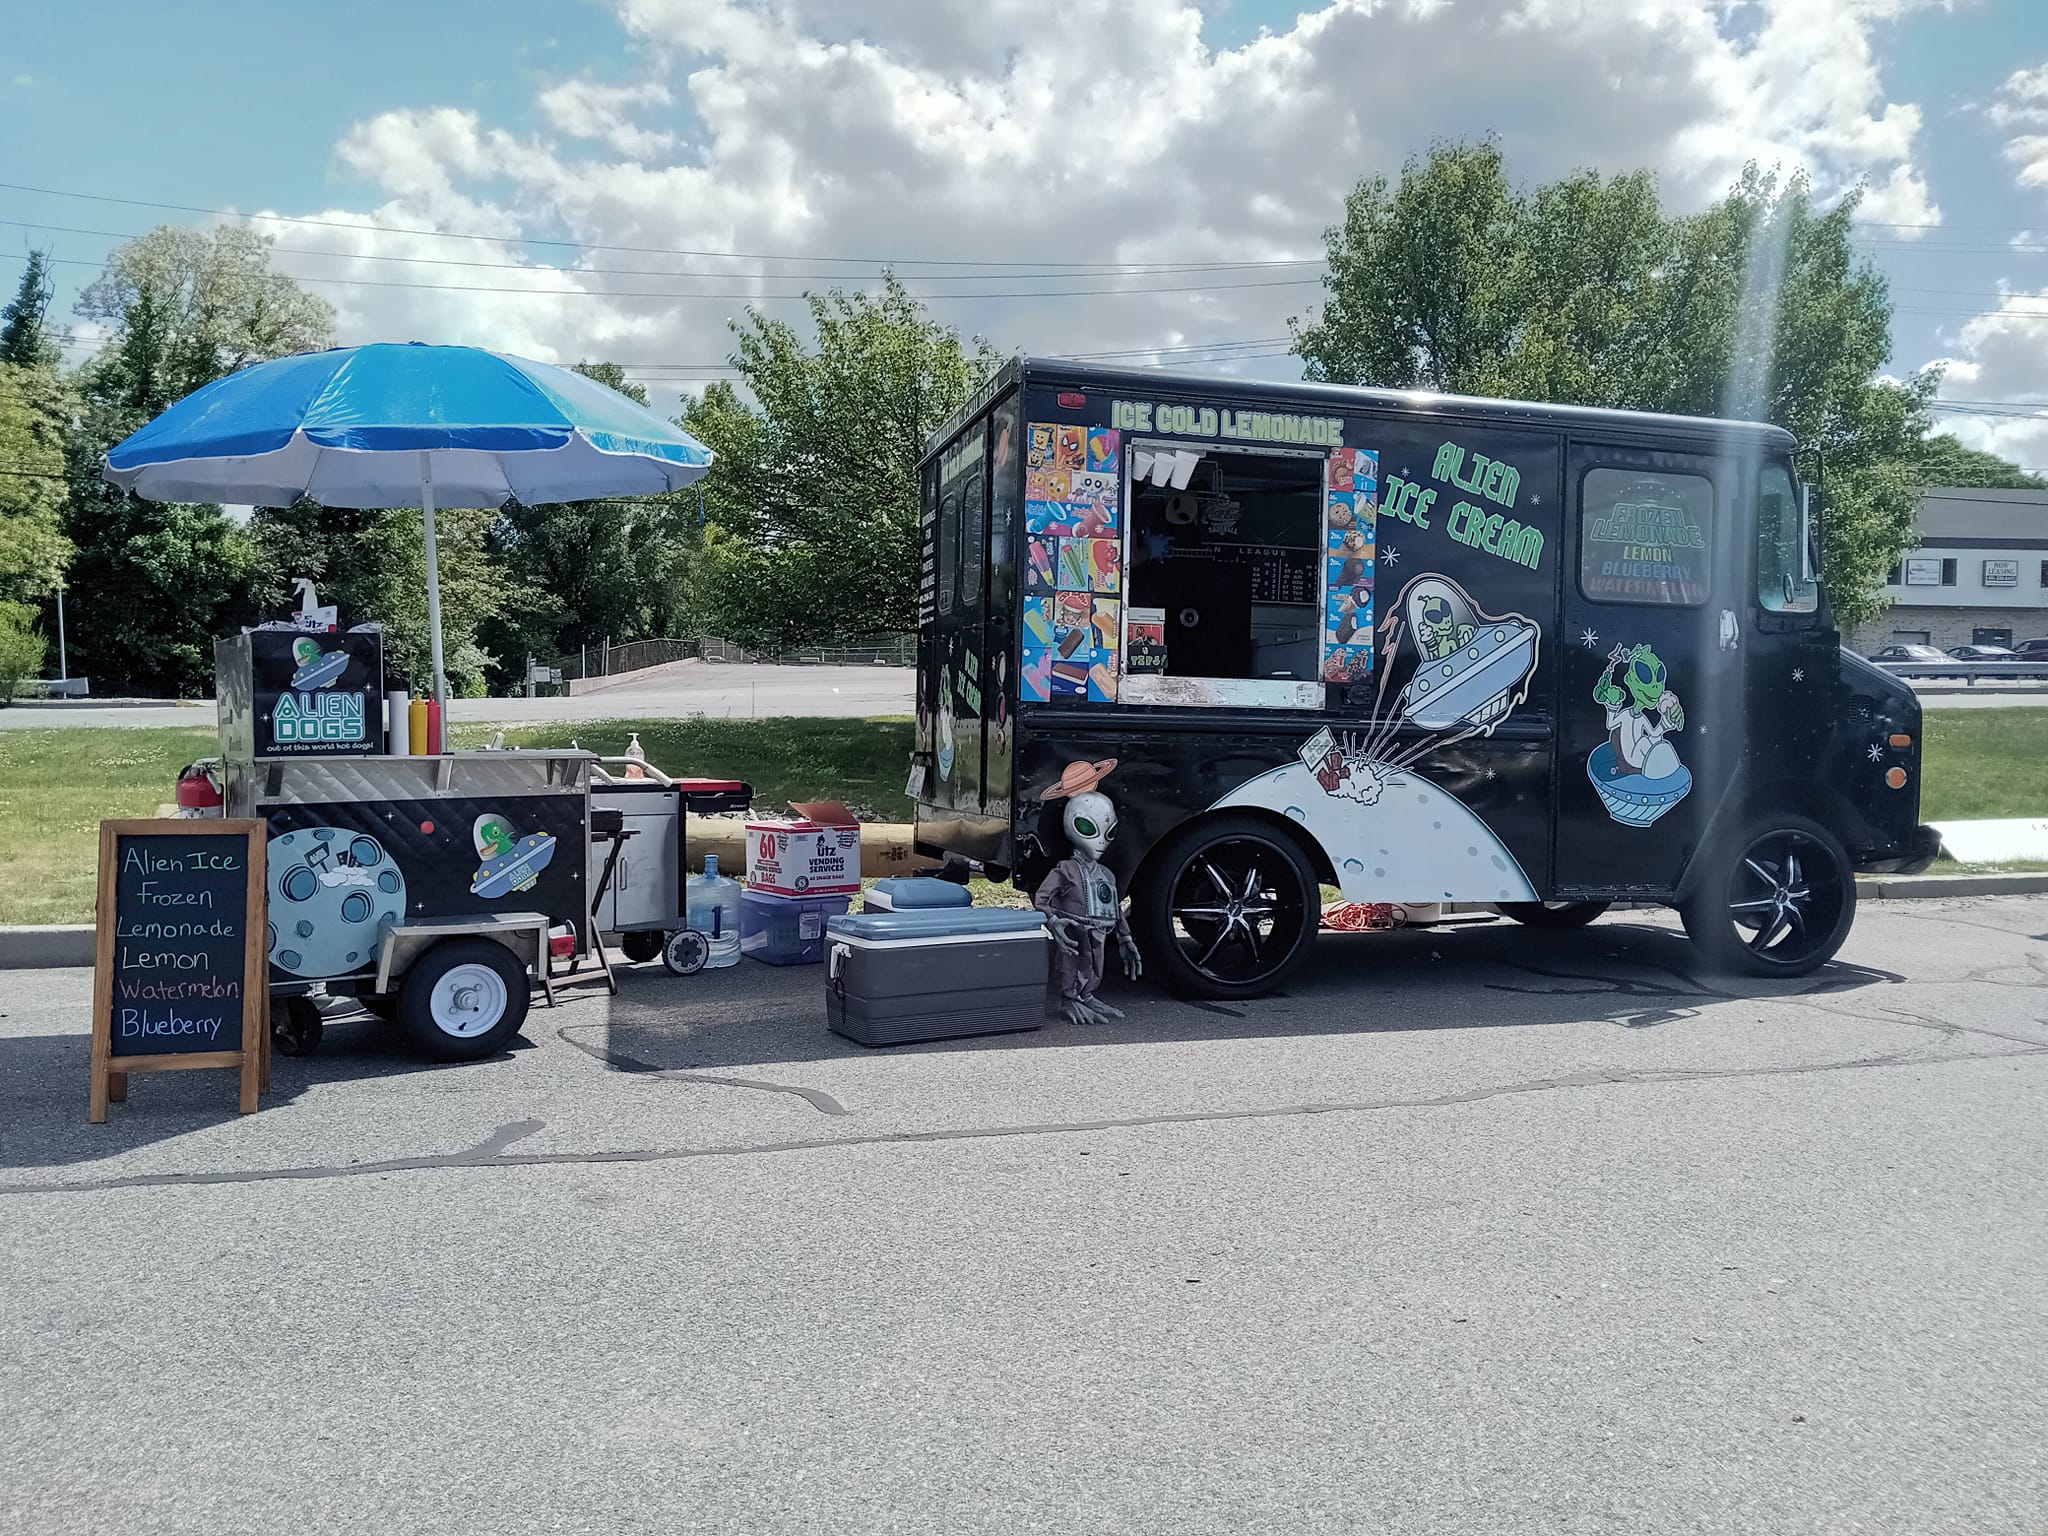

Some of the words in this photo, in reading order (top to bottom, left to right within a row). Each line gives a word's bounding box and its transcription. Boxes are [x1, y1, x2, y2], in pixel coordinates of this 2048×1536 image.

[1112, 400, 1152, 431] ICE
[1156, 404, 1218, 437] COLD
[1221, 409, 1344, 447] LEMONADE
[1432, 441, 1520, 508] ALIEN
[1378, 474, 1438, 529] ICE
[1447, 501, 1544, 570] CREAM
[1612, 504, 1685, 528] FROZEN
[1592, 520, 1705, 548] LEMONADE
[1239, 547, 1287, 557] LEAGUE
[1623, 546, 1672, 562] LEMON
[1601, 561, 1692, 580] BLUEBERRY
[273, 692, 365, 718] ALIEN
[274, 717, 366, 743] DOGS
[266, 744, 282, 752] out
[282, 744, 293, 752] of
[293, 743, 310, 751] this
[311, 742, 335, 750] world
[336, 741, 351, 750] hot
[352, 741, 374, 751] dogs!
[759, 833, 776, 860] 60
[124, 848, 183, 875] Alien
[186, 852, 241, 870] Ice
[808, 857, 844, 866] VENDING
[808, 865, 844, 873] SERVICES
[761, 872, 776, 884] BAGS
[136, 881, 213, 909] Frozen
[117, 916, 235, 938] Lemonade
[122, 947, 209, 970] Lemon
[119, 976, 239, 999] Watermelon
[122, 1009, 222, 1040] Blueberry
